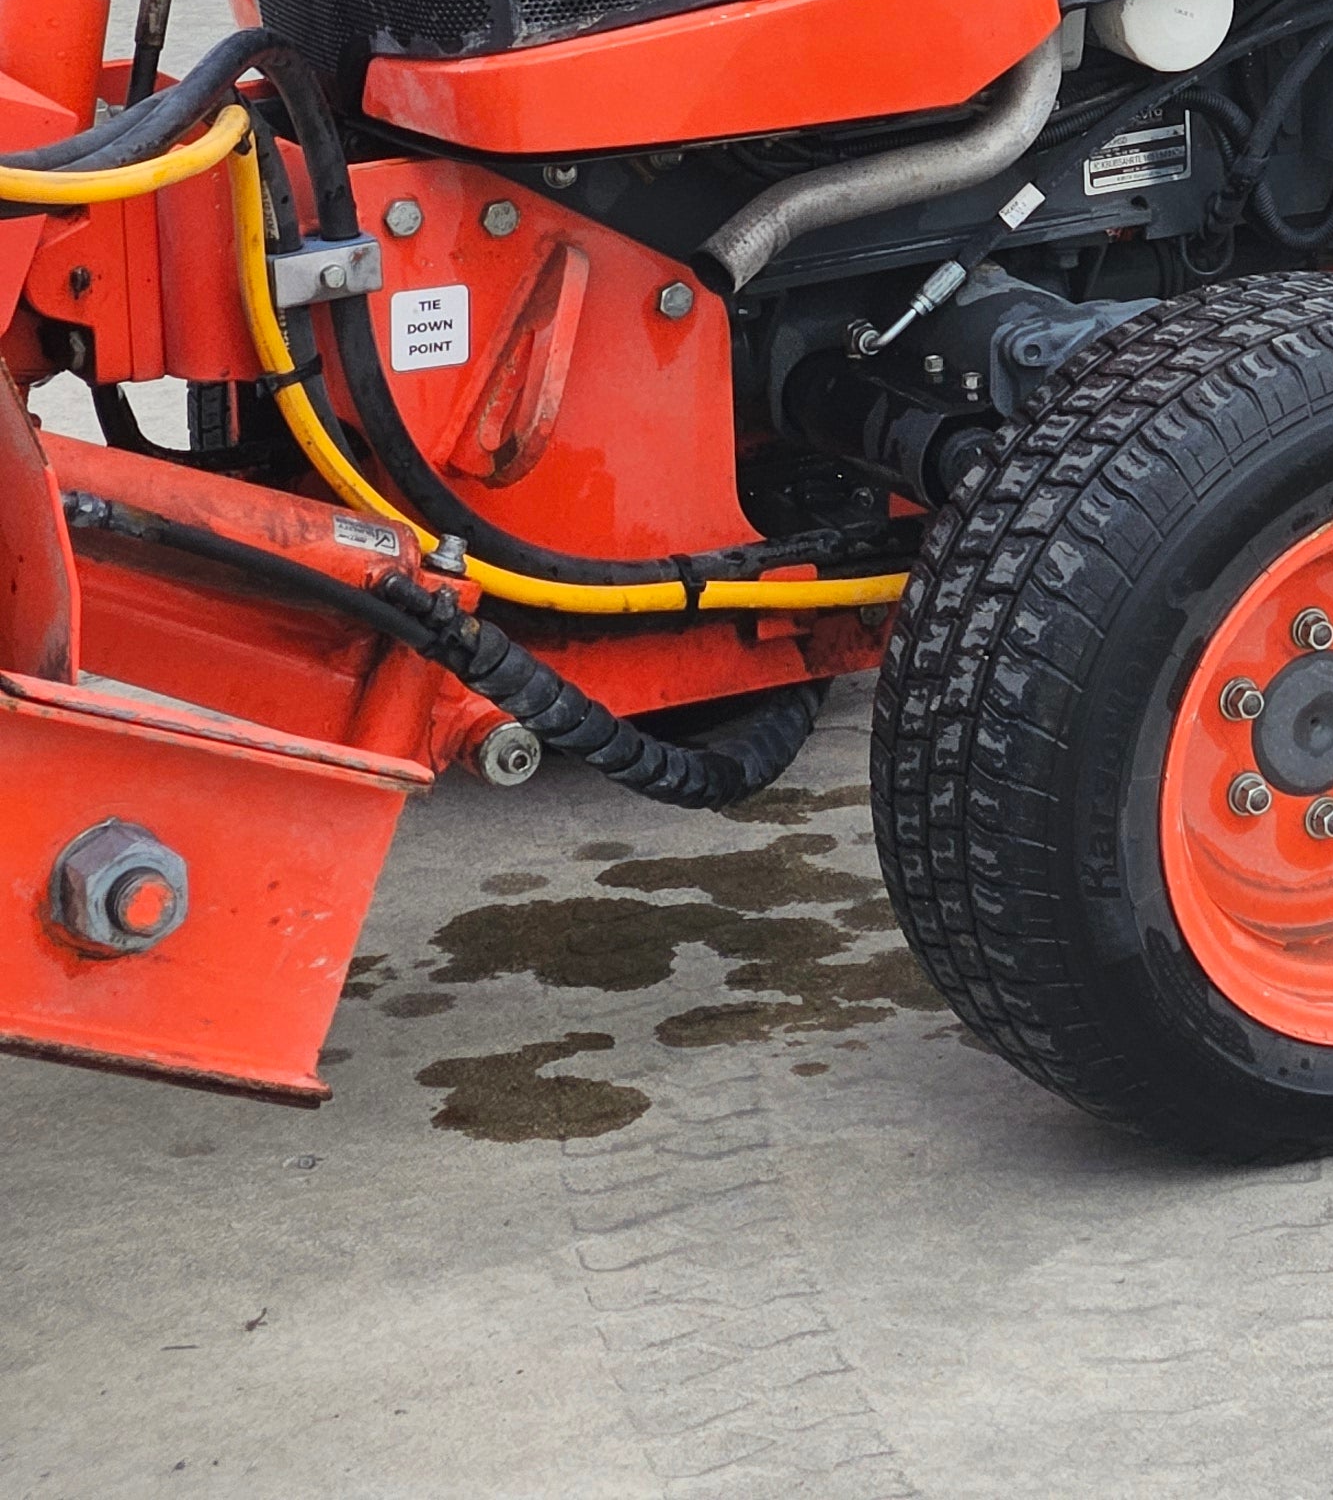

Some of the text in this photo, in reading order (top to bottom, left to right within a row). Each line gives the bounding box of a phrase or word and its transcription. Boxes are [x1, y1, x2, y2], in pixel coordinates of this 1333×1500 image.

[418, 299, 441, 312] TIE
[407, 319, 453, 335] DOWN
[408, 340, 452, 356] POINT
